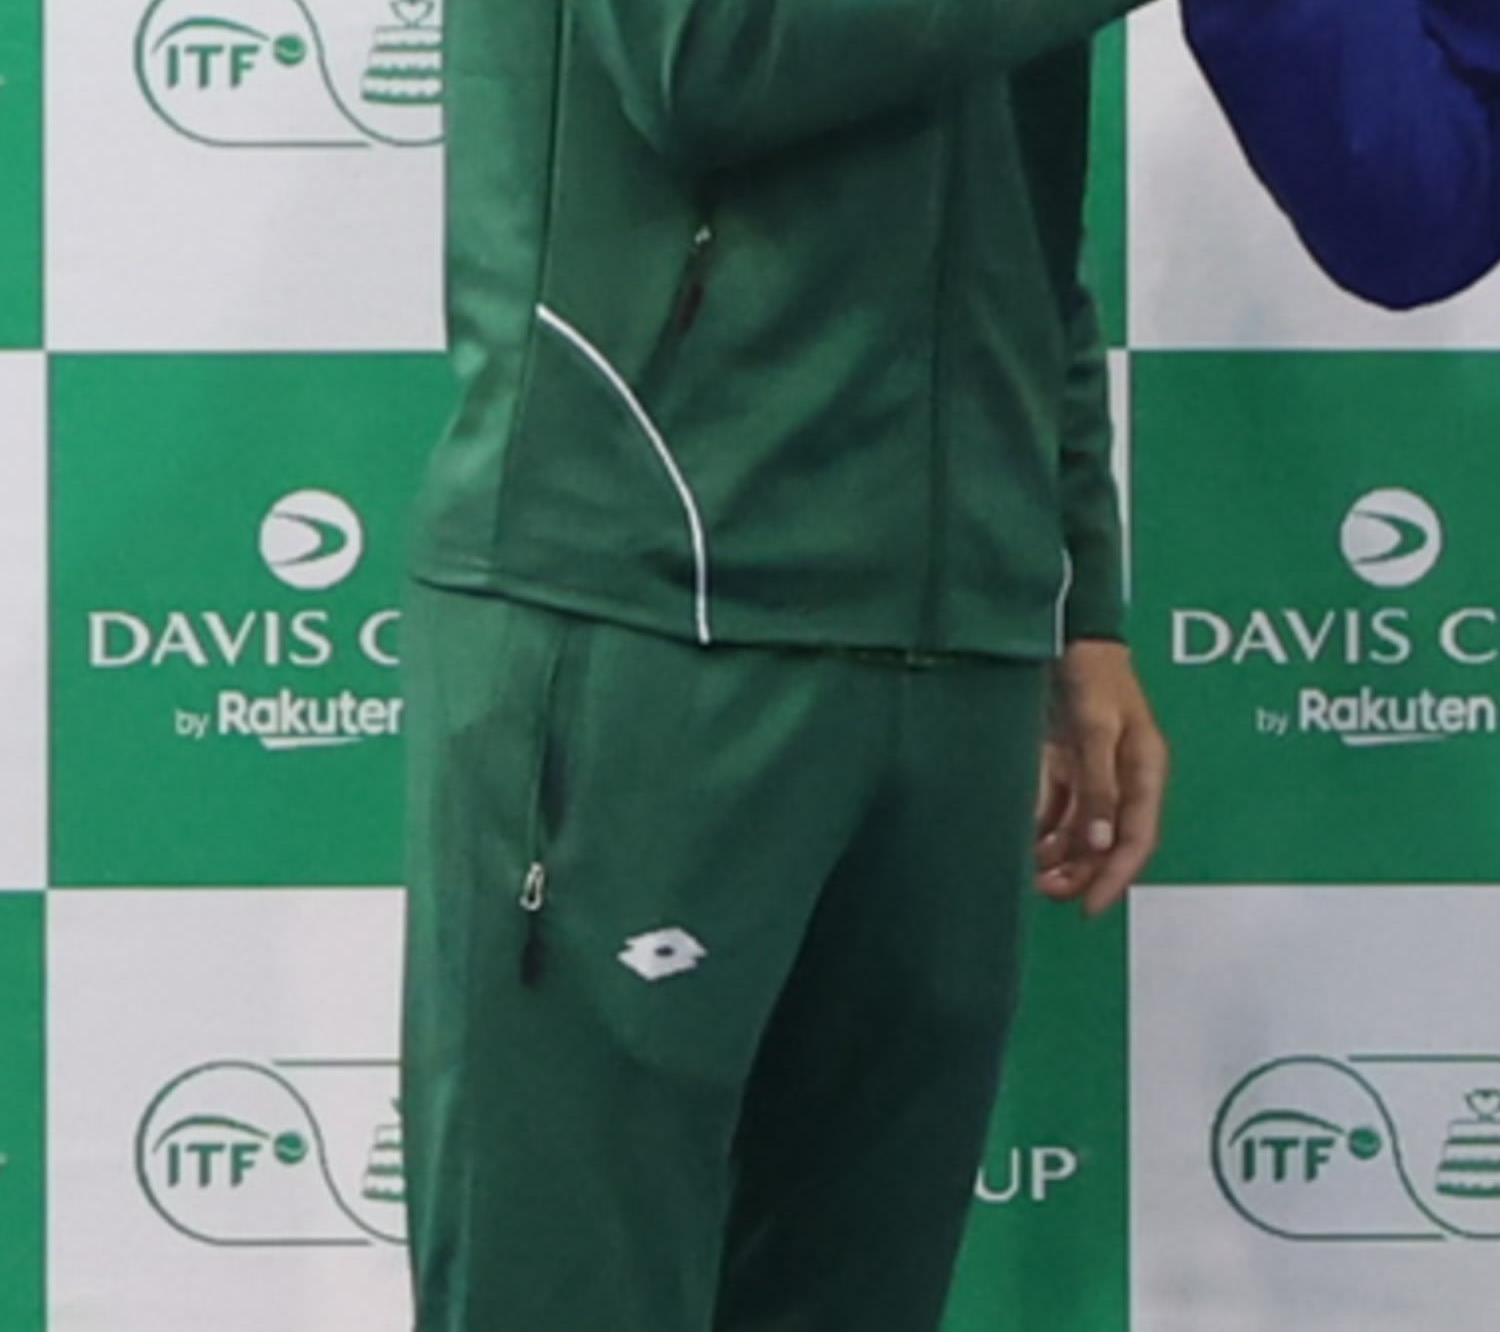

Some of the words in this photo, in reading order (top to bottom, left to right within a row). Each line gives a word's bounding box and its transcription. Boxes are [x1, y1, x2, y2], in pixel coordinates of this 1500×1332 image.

[165, 43, 261, 89] ITF
[89, 610, 332, 667] DAVIS
[1171, 607, 1411, 665] DAVIS
[174, 709, 209, 739] by
[1255, 706, 1289, 736] by
[1298, 686, 1497, 733] Rakuten
[166, 1140, 262, 1188] ITF
[974, 1147, 1078, 1203] UP
[1240, 1134, 1336, 1183] ITF
